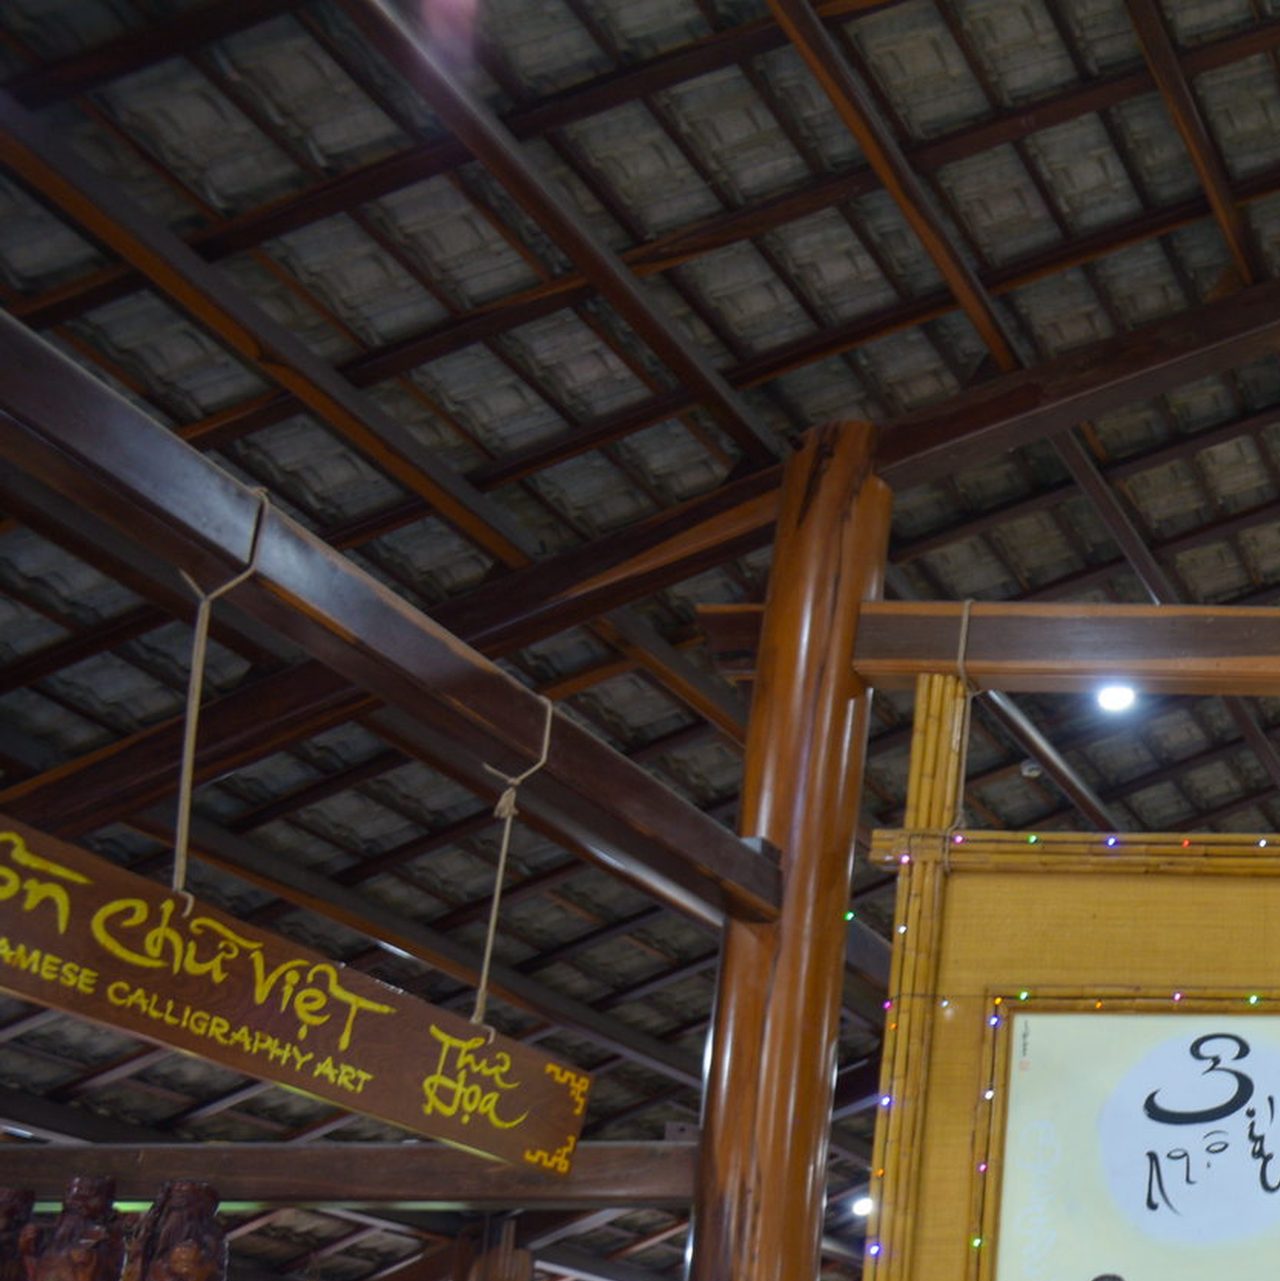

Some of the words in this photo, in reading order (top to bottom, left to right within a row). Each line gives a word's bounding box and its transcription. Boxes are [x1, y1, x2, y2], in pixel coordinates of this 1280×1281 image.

[0, 937, 98, 994] AMESE
[107, 980, 314, 1071] CALLIGRAPHY
[313, 1056, 375, 1094] ART
